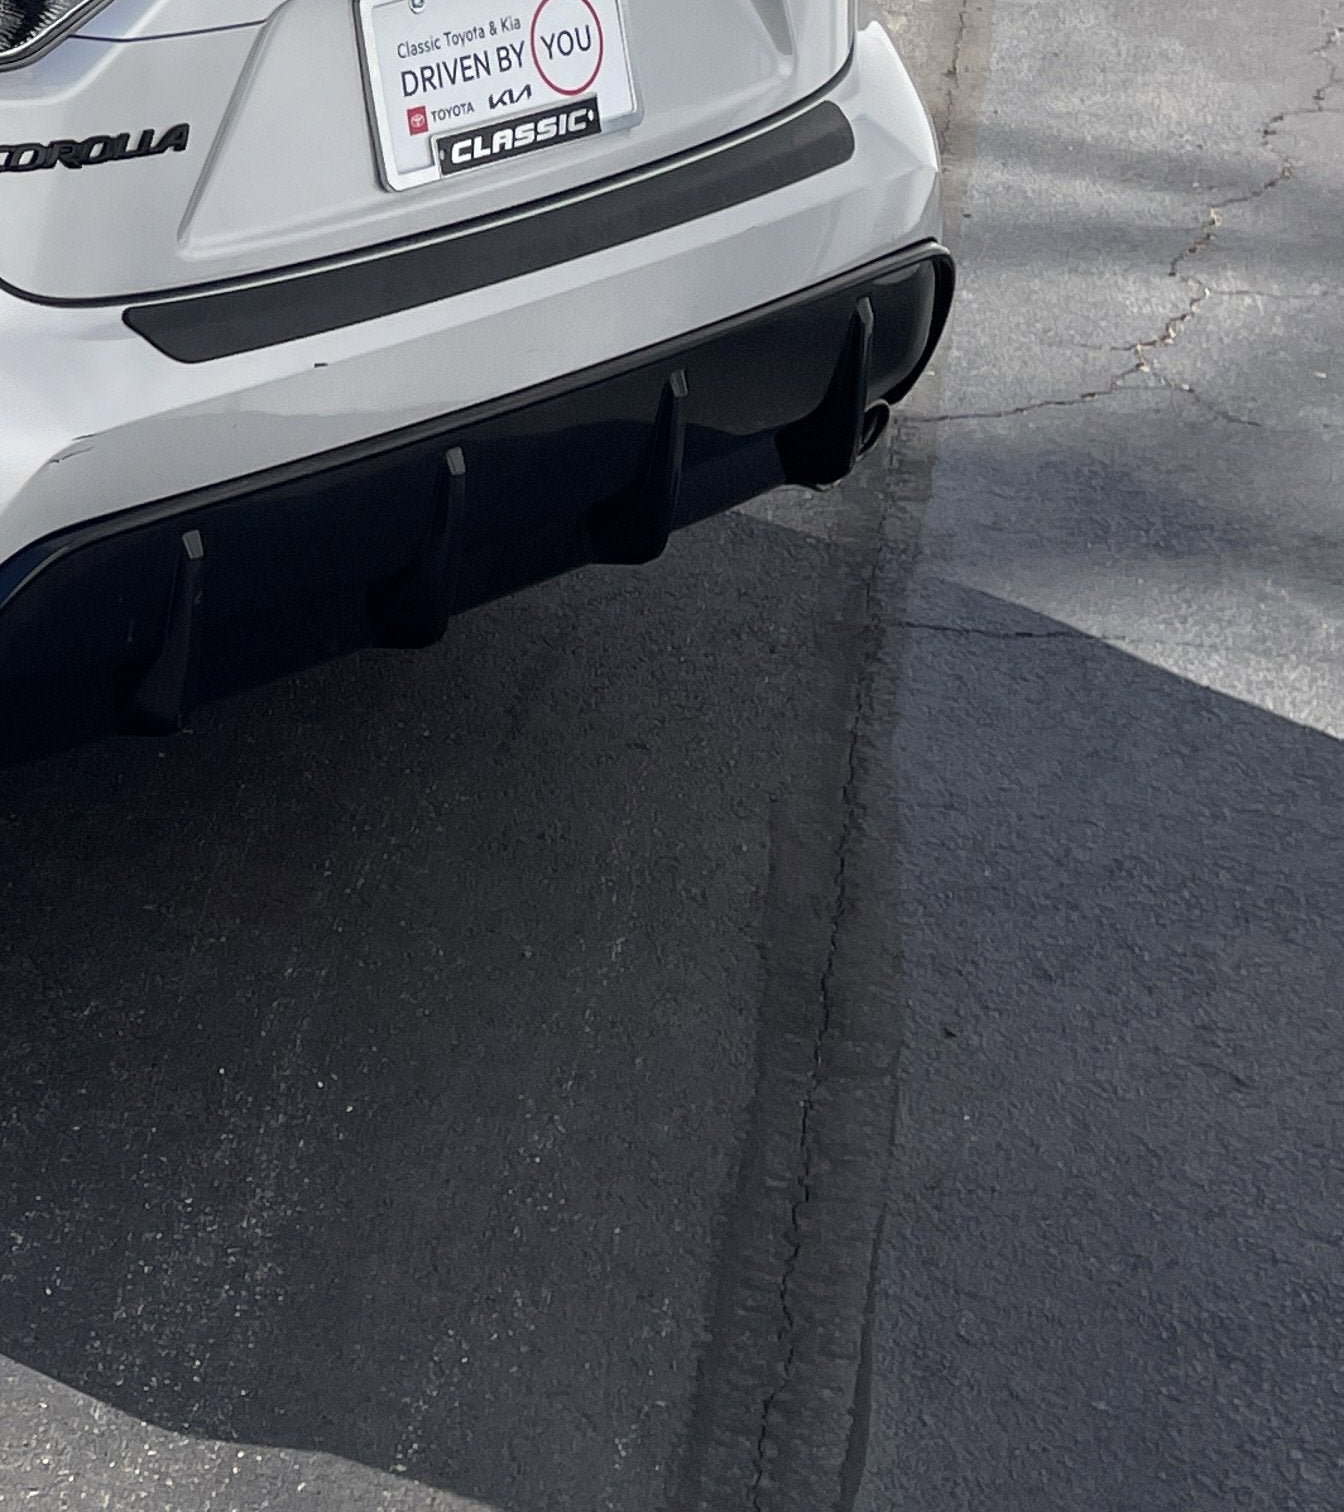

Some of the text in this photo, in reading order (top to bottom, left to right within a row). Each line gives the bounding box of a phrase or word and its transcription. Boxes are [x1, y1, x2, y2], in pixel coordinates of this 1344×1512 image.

[396, 15, 522, 59] Classic Toyota & Kia
[400, 24, 593, 98] DRIVEN BY YOU
[431, 101, 474, 123] TOYOTA
[450, 108, 588, 165] CLASSIC
